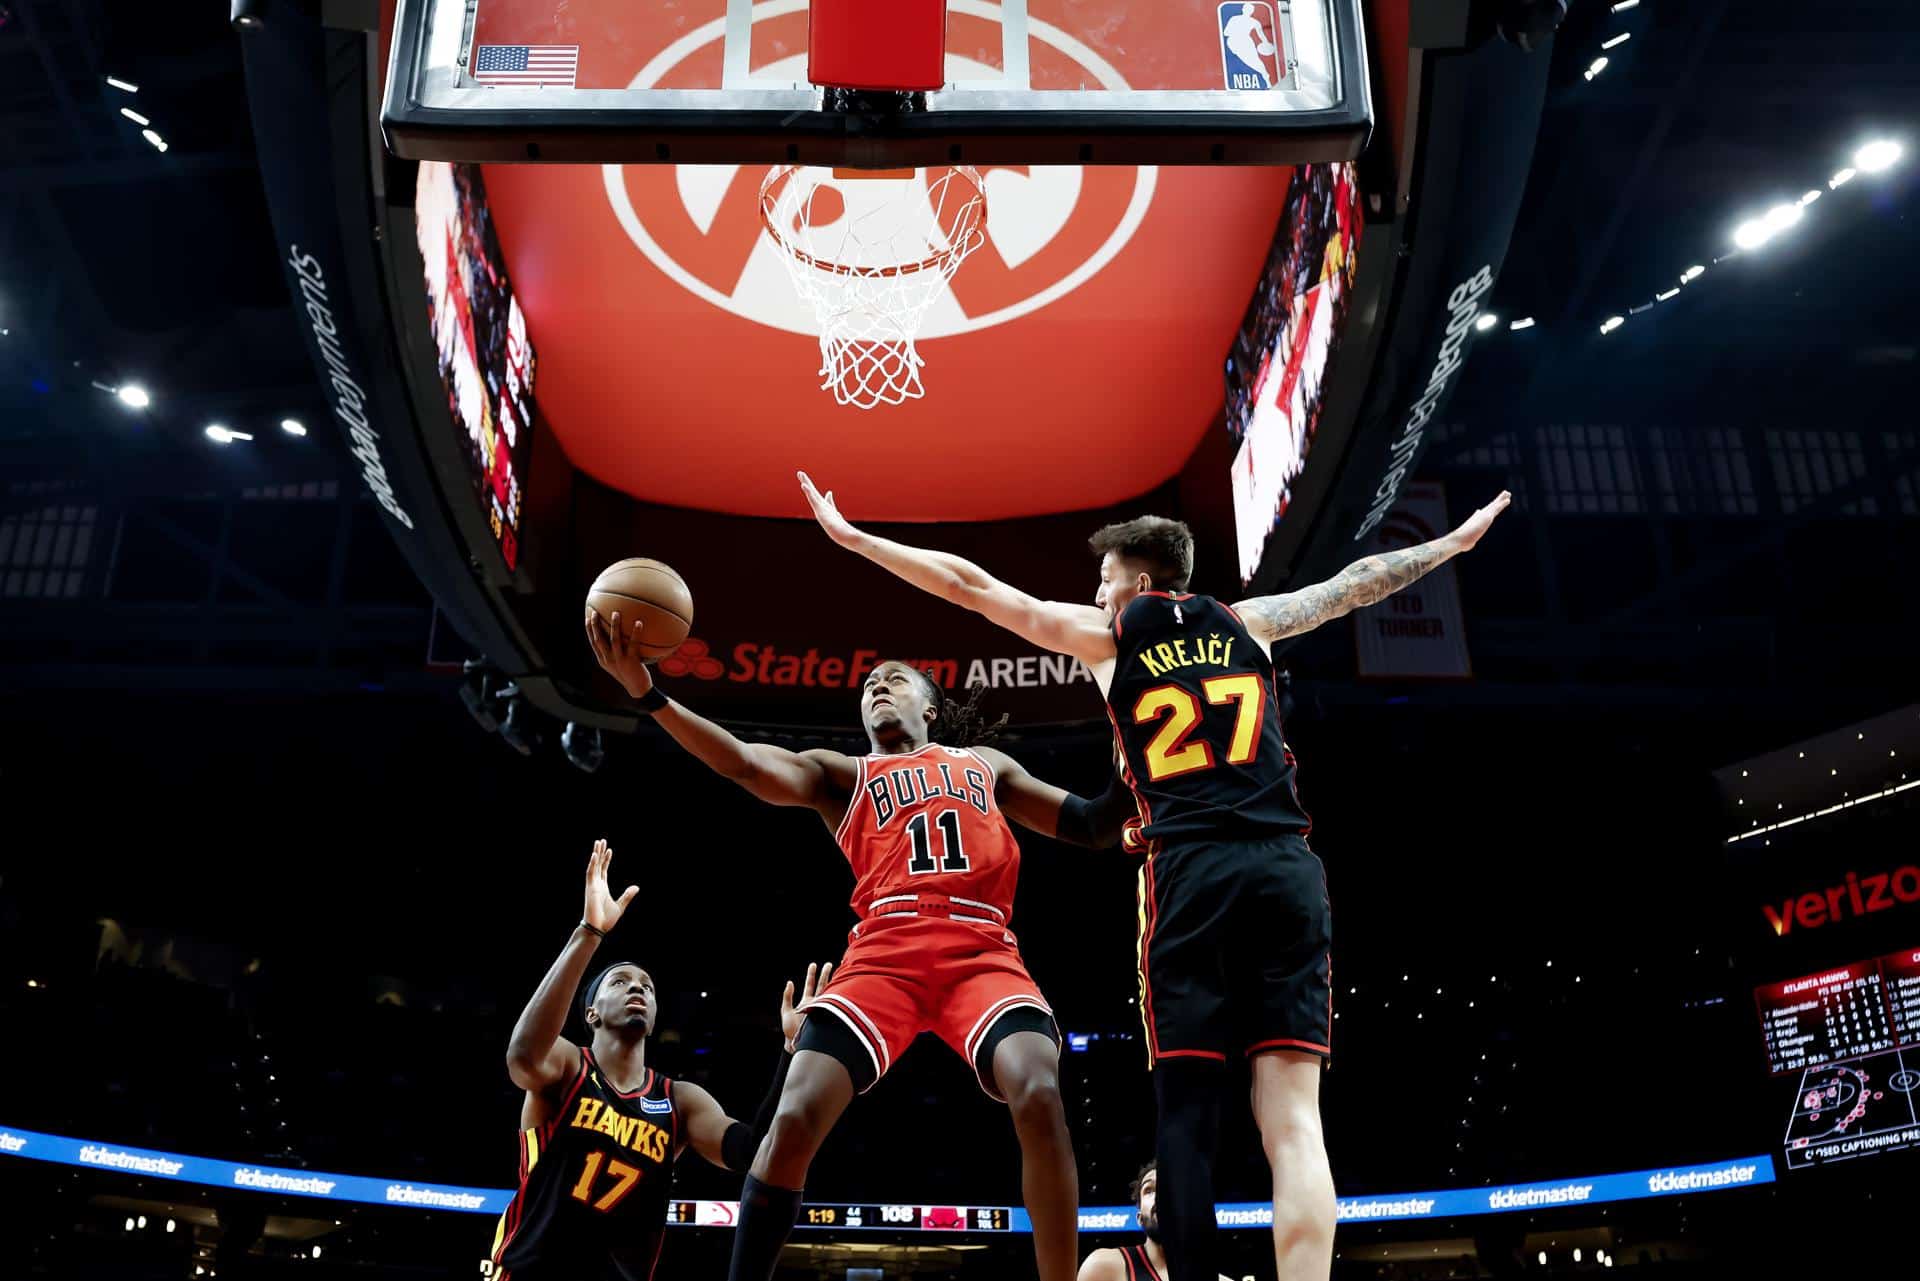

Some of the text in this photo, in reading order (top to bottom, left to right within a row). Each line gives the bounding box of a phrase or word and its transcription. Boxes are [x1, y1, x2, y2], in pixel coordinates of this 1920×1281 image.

[1233, 74, 1260, 89] NBA
[289, 244, 413, 529] globalpayments
[1138, 633, 1236, 677] KREJČÍ
[964, 655, 1096, 689] ARENA
[1132, 673, 1267, 782] 27
[866, 763, 989, 831] BULLS
[906, 809, 971, 875] 11
[1783, 970, 1850, 994] ATLANTA HAWKS
[570, 1097, 670, 1164] HAWKS
[1842, 1133, 1900, 1153] CAPTIONING
[80, 1145, 184, 1176] ticketmaster
[234, 1168, 336, 1195] ticketmaster
[571, 1150, 644, 1213] 17
[1648, 1164, 1757, 1193] ticketmaster
[386, 1184, 486, 1209] ticketmaster
[1488, 1184, 1592, 1209] ticketmaster
[807, 1209, 835, 1224] 1:19
[880, 1206, 914, 1222] 108
